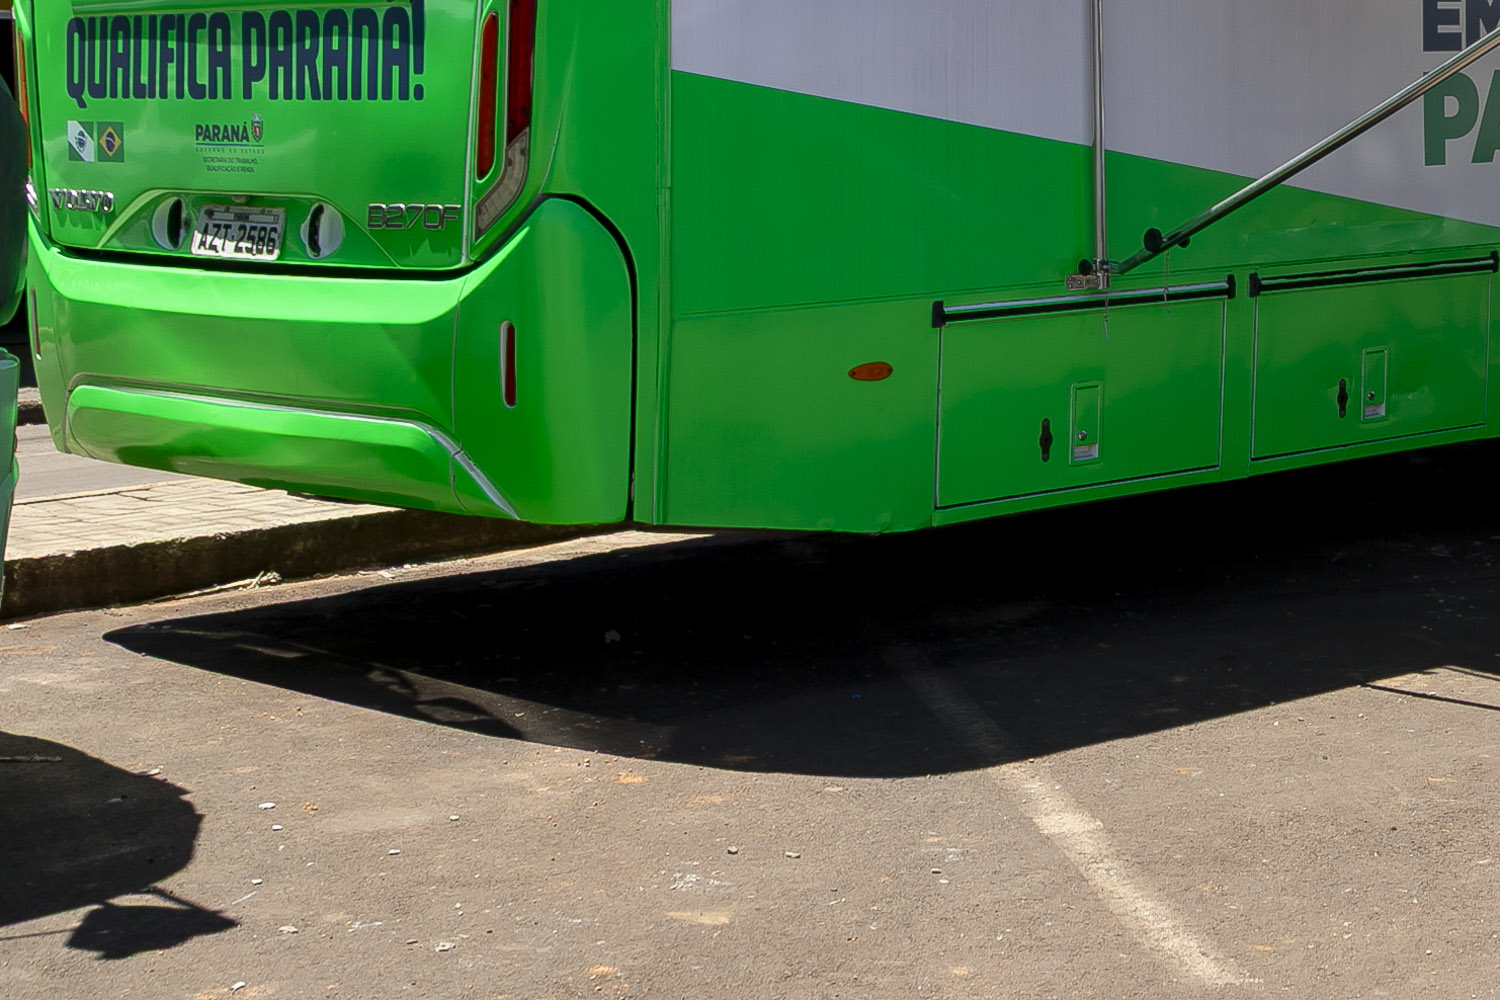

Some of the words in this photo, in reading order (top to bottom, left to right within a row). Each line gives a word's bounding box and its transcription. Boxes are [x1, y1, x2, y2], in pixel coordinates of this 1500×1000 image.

[66, 11, 232, 109] QUALIFICA
[195, 121, 250, 142] PARANÁ
[49, 188, 114, 213] VOLVO
[367, 203, 461, 230] B270F
